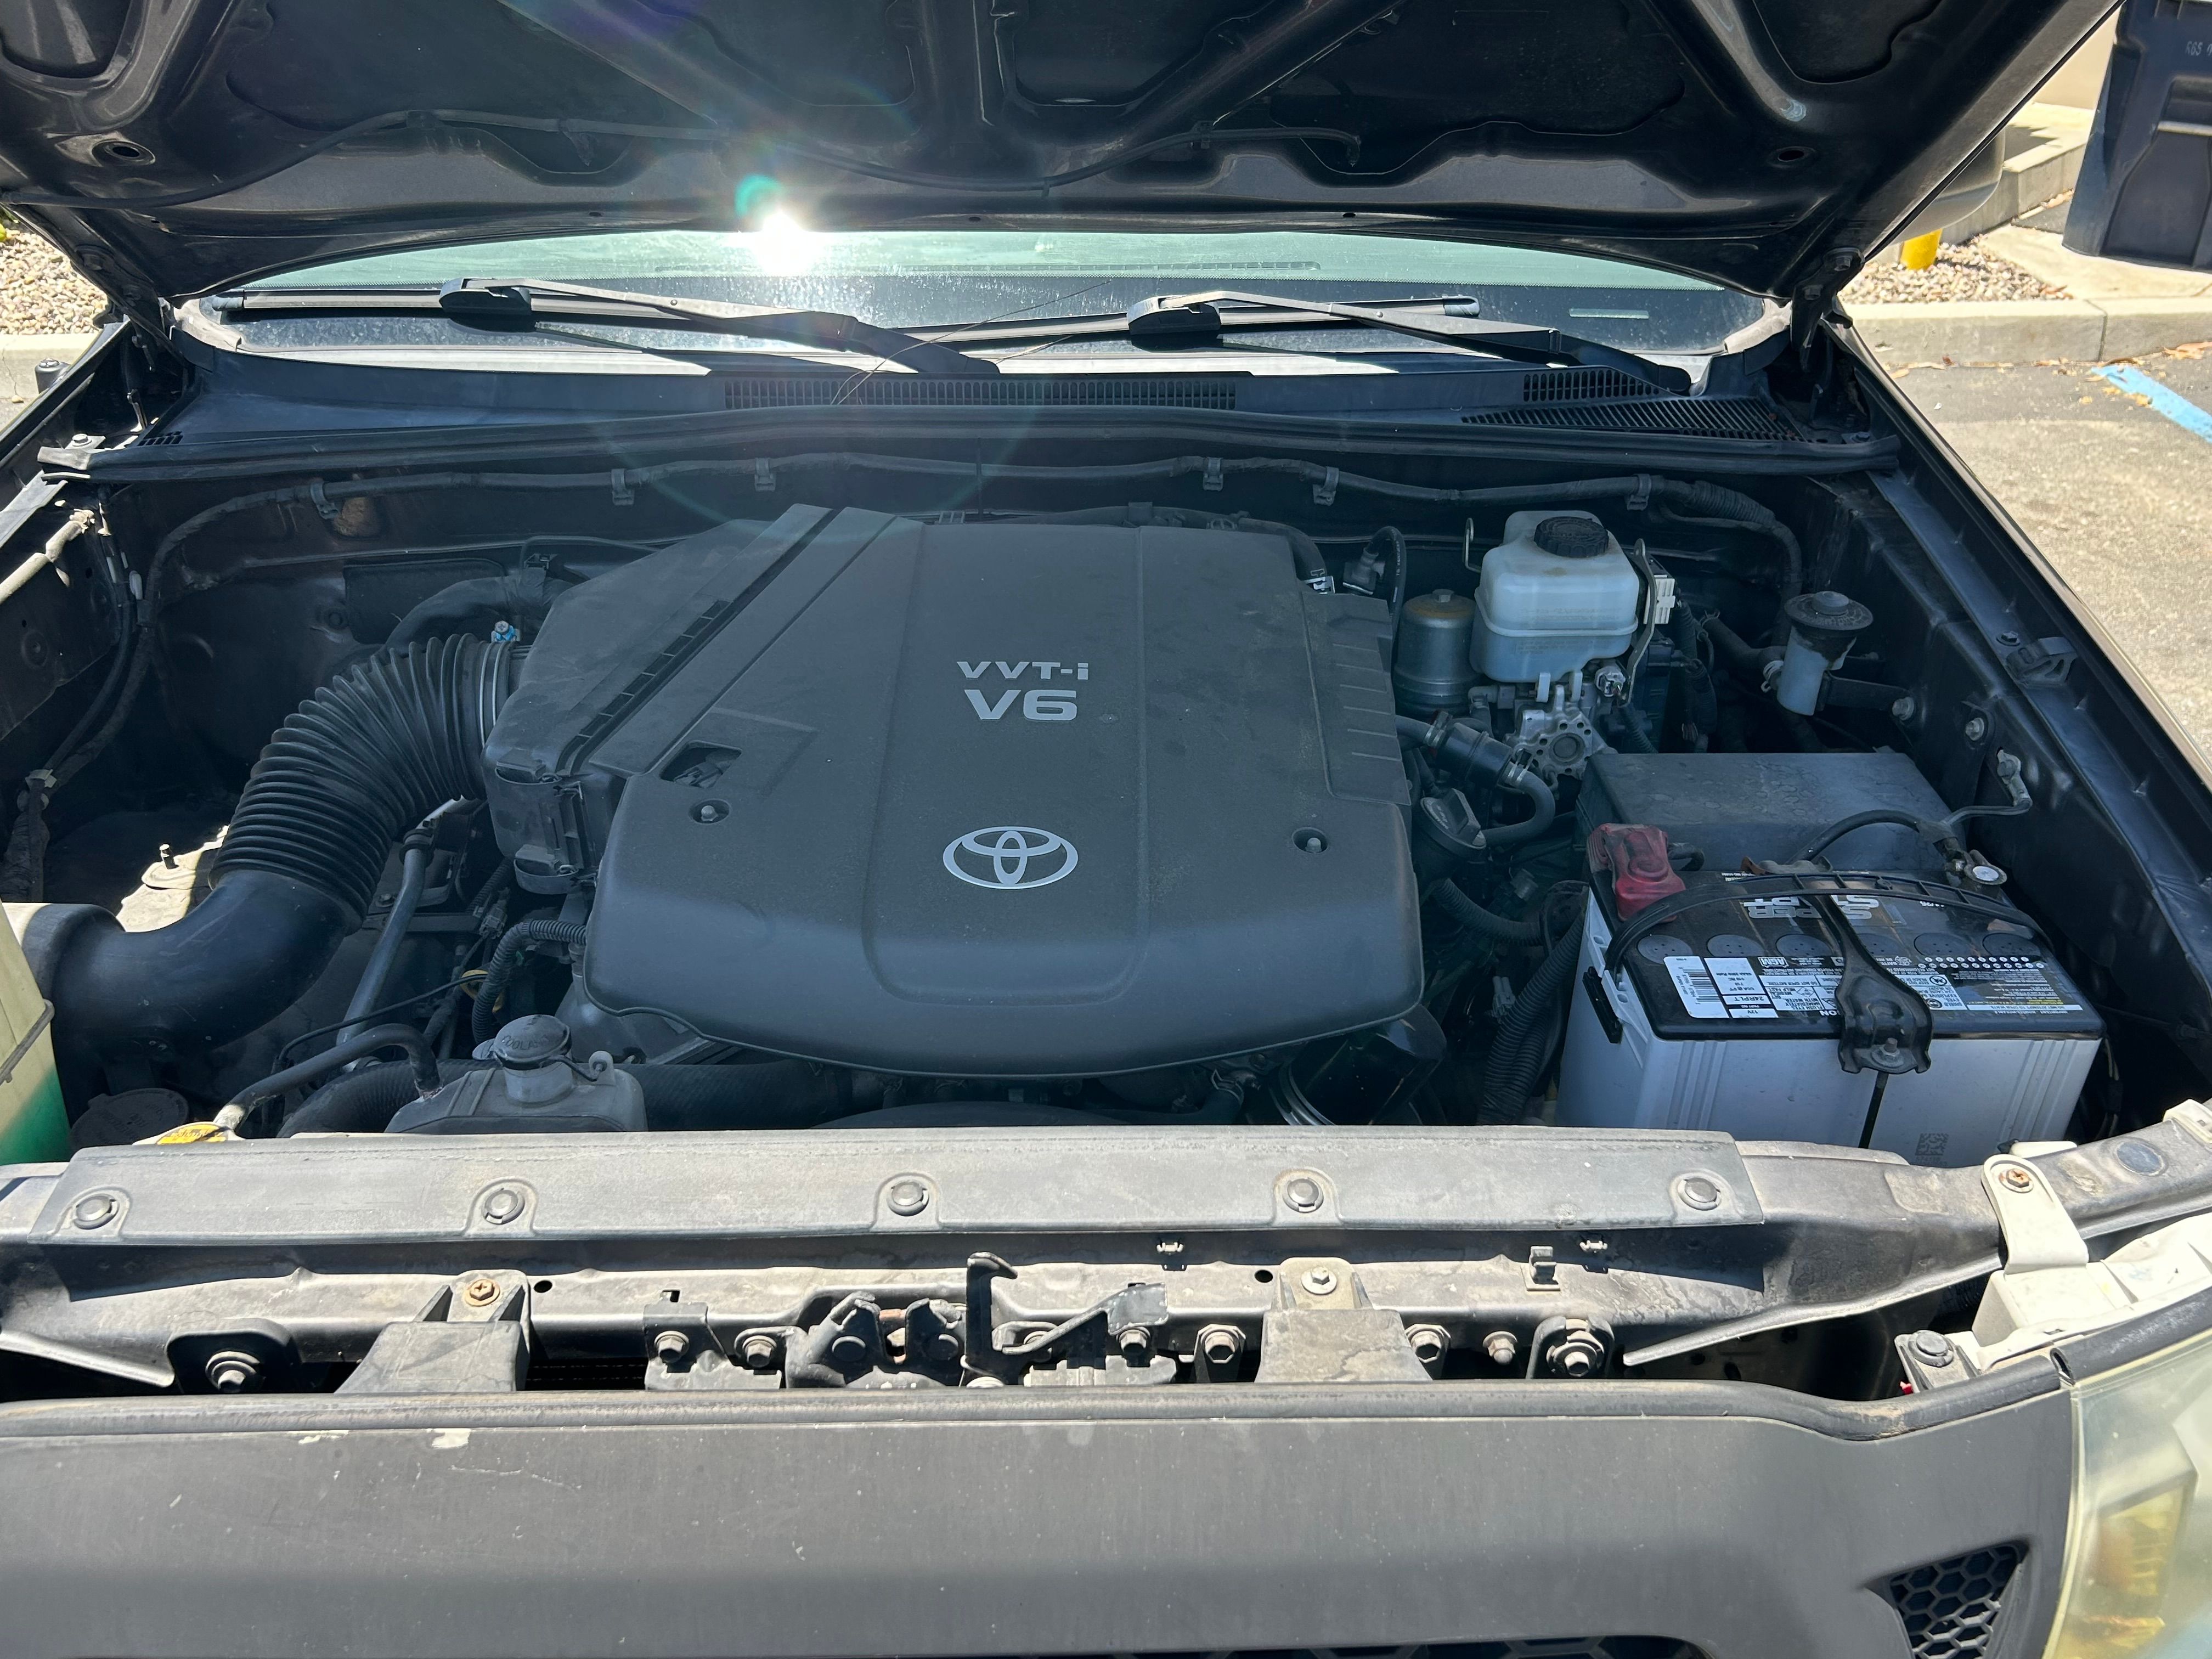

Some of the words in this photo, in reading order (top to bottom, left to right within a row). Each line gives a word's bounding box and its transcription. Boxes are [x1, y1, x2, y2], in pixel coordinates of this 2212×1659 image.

[957, 662, 1088, 680] VVT-i
[964, 689, 1077, 721] V6
[1748, 905, 1872, 919] SPER
